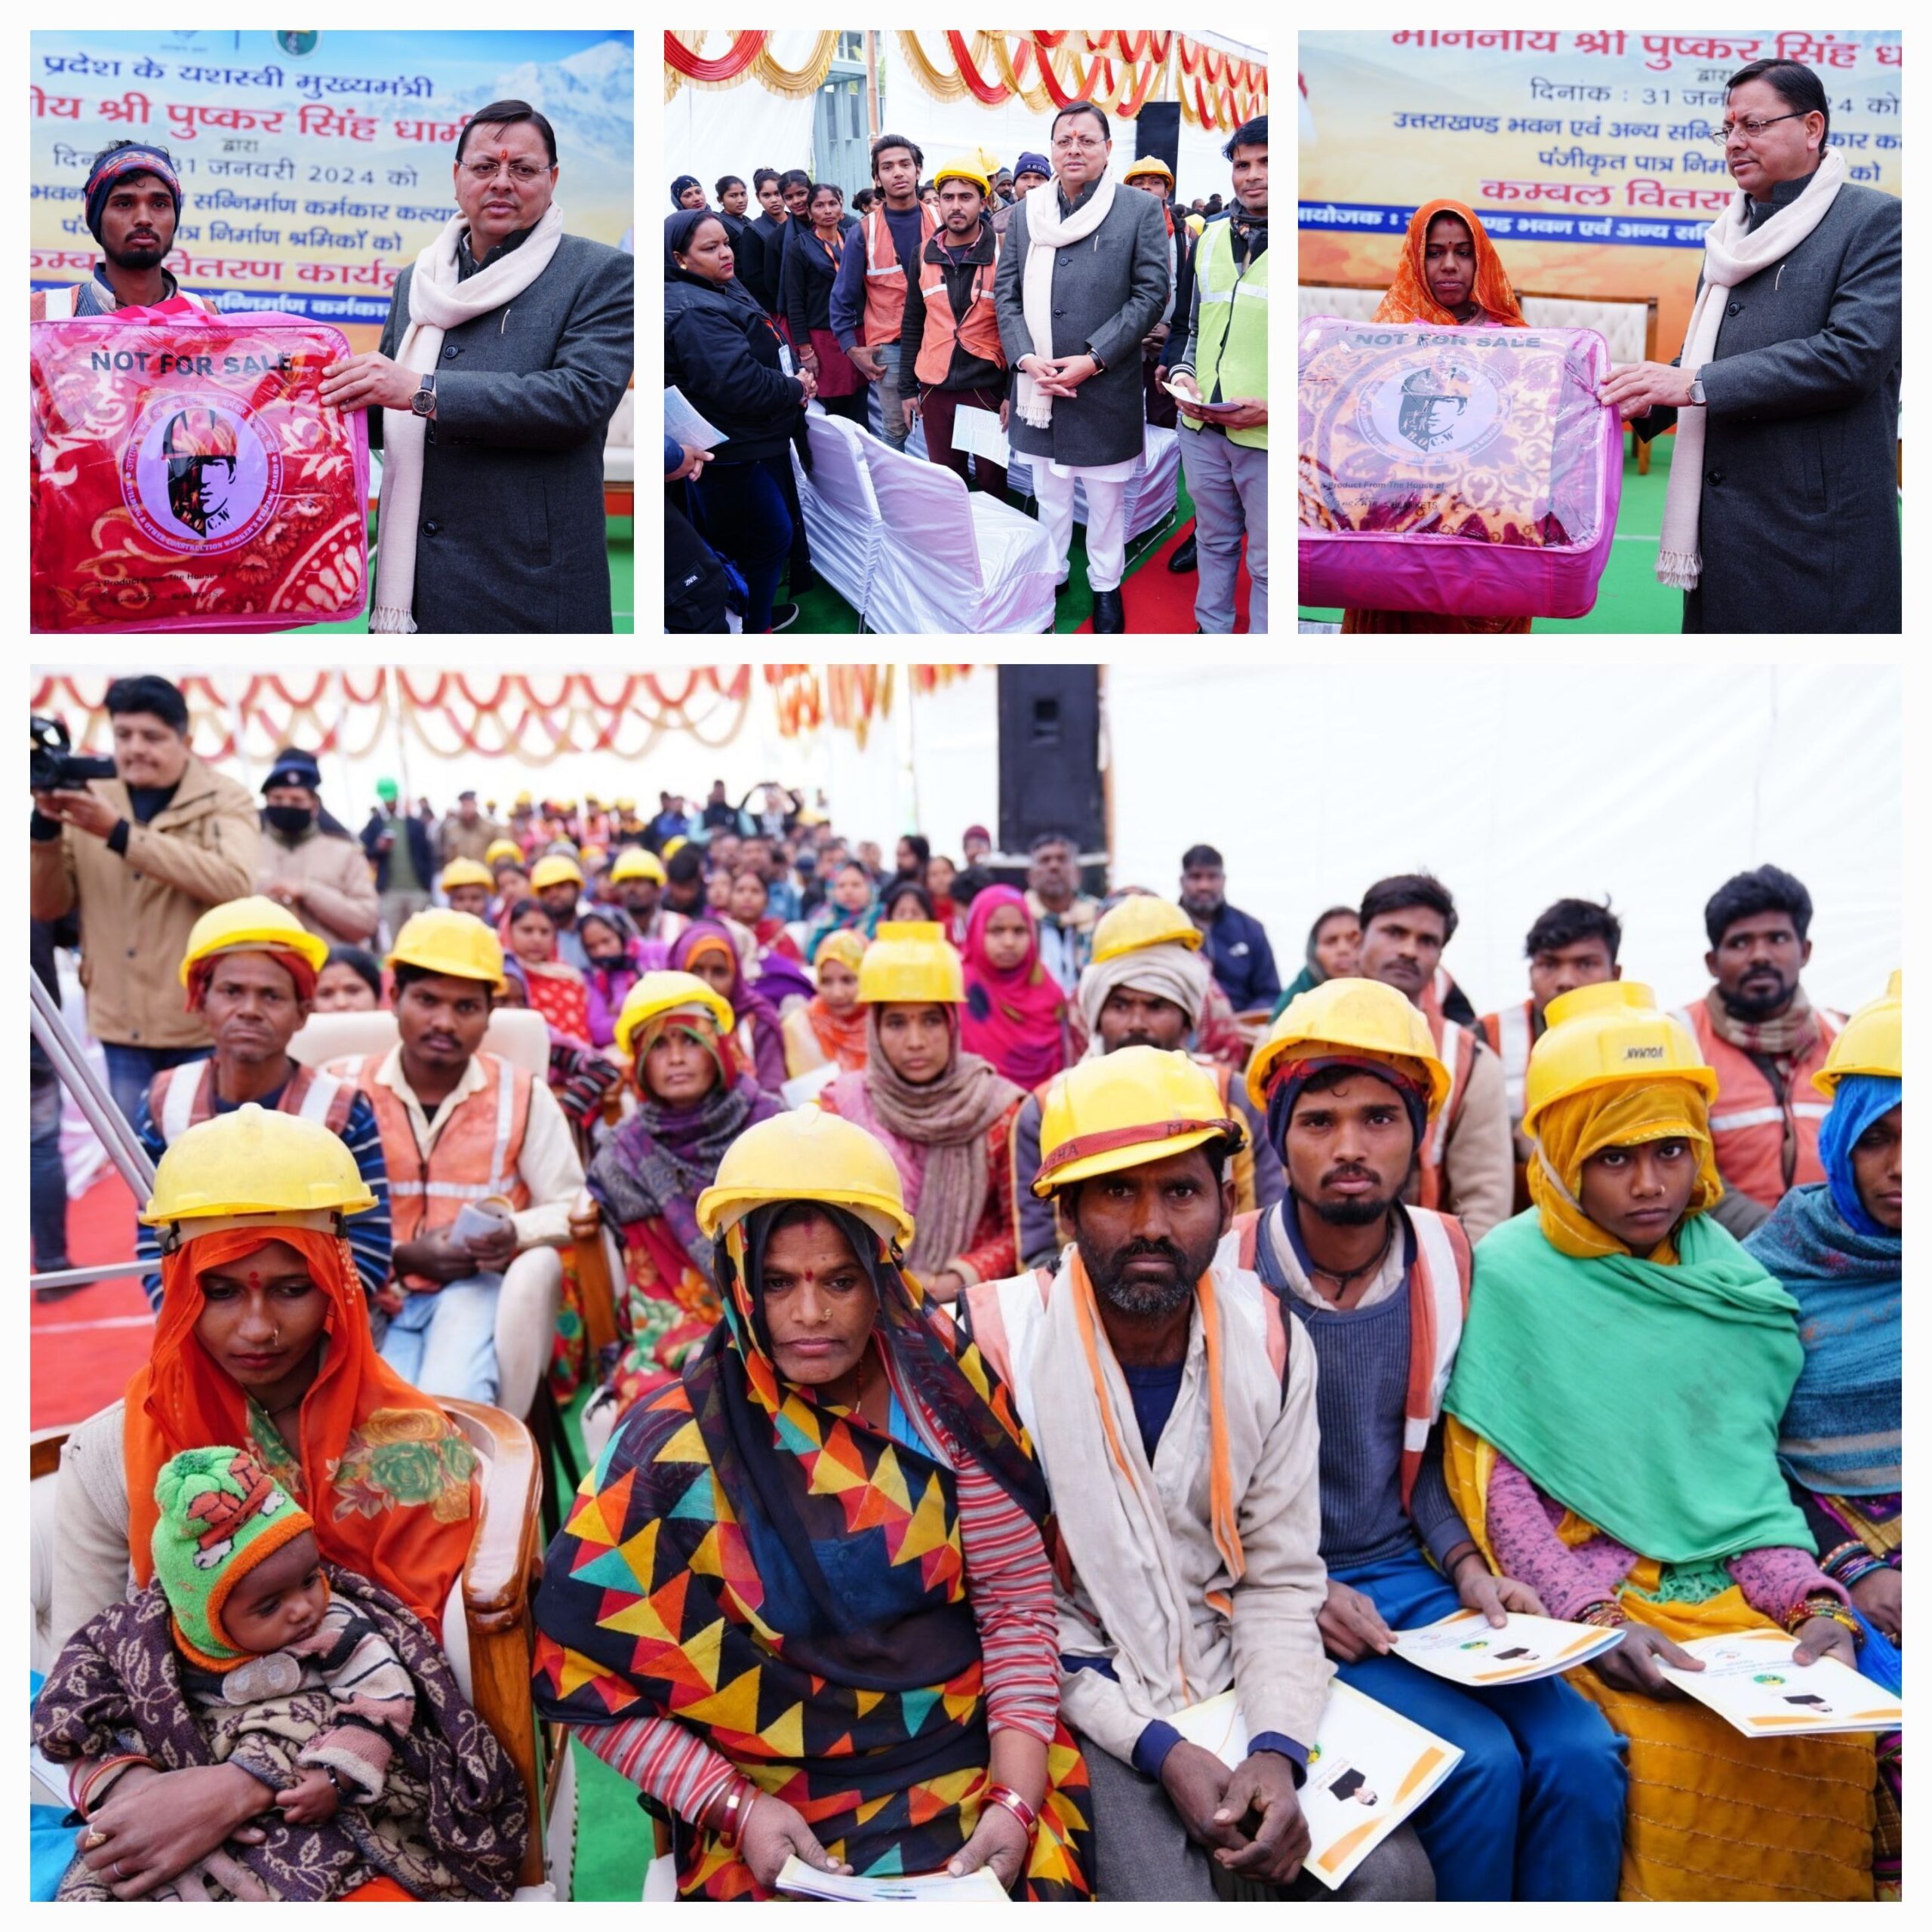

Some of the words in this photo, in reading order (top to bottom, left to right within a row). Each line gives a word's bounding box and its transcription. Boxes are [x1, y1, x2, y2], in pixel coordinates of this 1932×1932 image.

[1641, 35, 1764, 70] पुष्कर
[1775, 32, 1860, 69] सिंह
[43, 52, 122, 75] प्रदेश
[133, 56, 167, 79] के
[179, 65, 284, 88] यशस्वी
[296, 75, 433, 100] मुख्यमंत्री
[1531, 75, 1612, 102] दिनांक
[1642, 88, 1670, 105] 31
[1866, 90, 1900, 115] को
[98, 91, 152, 124] श्री
[166, 103, 287, 140] पुष्कर
[297, 103, 380, 142] सिंह
[1393, 111, 1501, 133] उत्तराखण्ड
[1507, 118, 1562, 136] भवन
[1570, 115, 1601, 137] एवं
[1608, 121, 1661, 139] अन्य
[221, 138, 259, 153] द्वारा
[208, 156, 295, 180] जनवरी
[309, 165, 374, 184] 2024
[386, 164, 419, 187] को
[1538, 146, 1627, 177] पंजीकृत
[1635, 155, 1675, 172] पात्र
[1850, 161, 1881, 181] को
[193, 188, 297, 214] सन्निर्माण
[304, 195, 391, 219] कर्मकार
[1480, 179, 1616, 207] कम्बल
[210, 220, 280, 245] निर्माण
[372, 232, 401, 252] को
[1517, 217, 1574, 235] भवन
[1578, 217, 1613, 237] एवं
[1616, 223, 1671, 240] अन्य
[1355, 333, 1409, 346] NOT
[1417, 333, 1467, 346] FOR
[1476, 337, 1541, 348] SALE
[91, 351, 149, 371] NOT
[160, 353, 214, 376] FOR
[223, 351, 293, 374] SALE
[269, 464, 278, 490] BOARD
[104, 578, 139, 587] Product
